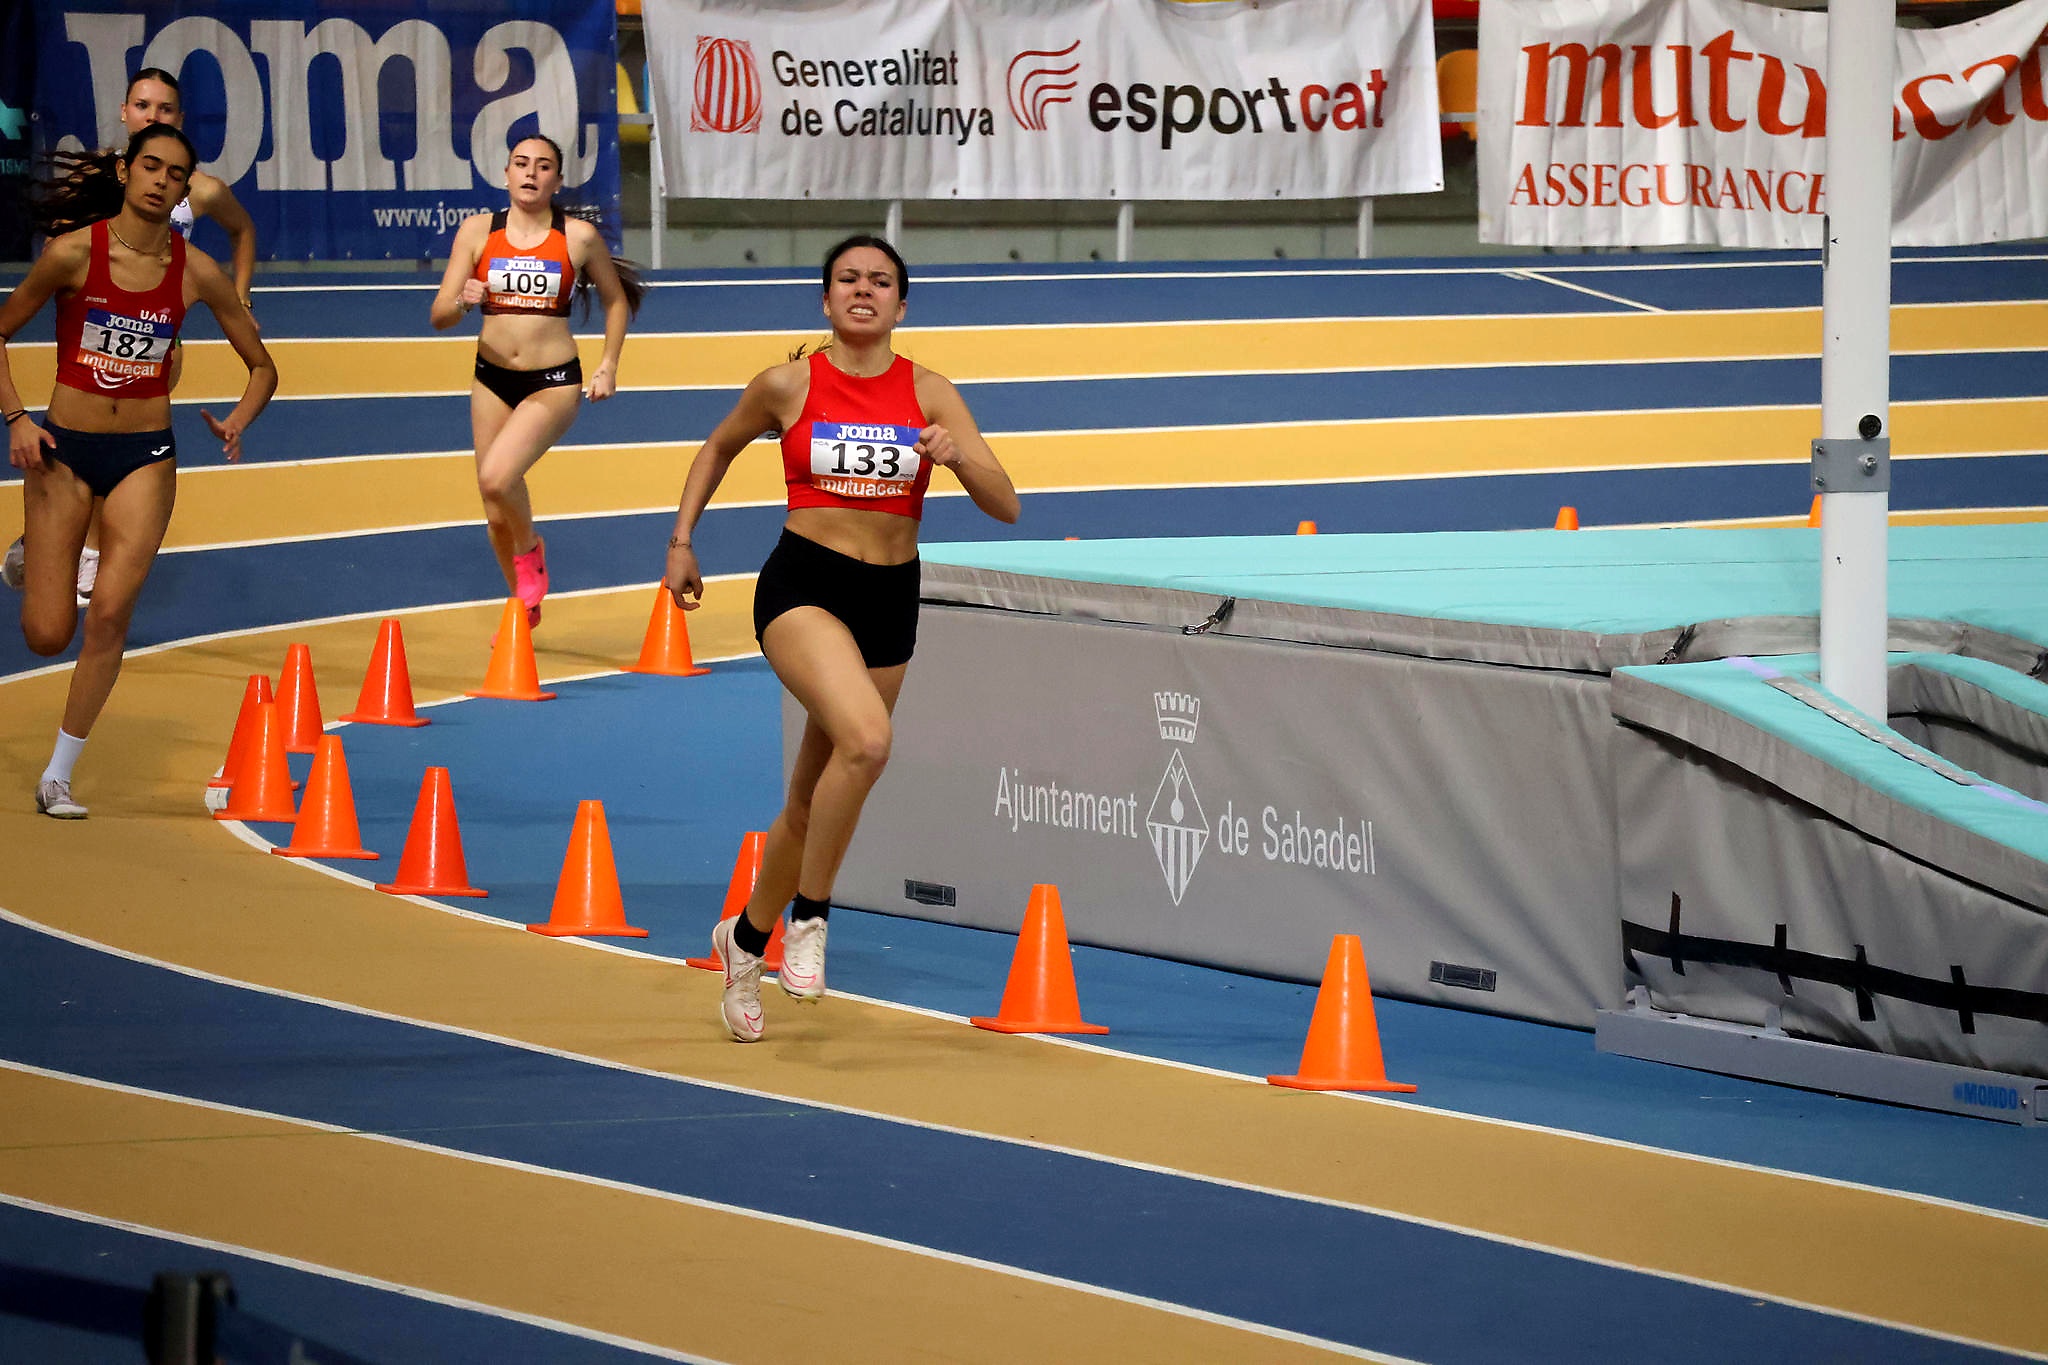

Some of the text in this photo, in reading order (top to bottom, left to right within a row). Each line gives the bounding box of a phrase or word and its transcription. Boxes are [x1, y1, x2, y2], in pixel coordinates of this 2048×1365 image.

[771, 49, 959, 88] Generalitat
[1514, 21, 2048, 141] mutucat
[780, 99, 994, 146] de Catalunya
[1088, 67, 1387, 149] esportcat
[502, 272, 547, 295] 109
[96, 329, 154, 360] 182
[82, 353, 155, 377] mutuacat
[831, 442, 901, 478] 133
[820, 479, 905, 497] mutuacat
[994, 766, 1377, 876] Ajuntament de Sabadell
[1963, 1082, 2018, 1110] MONDO
